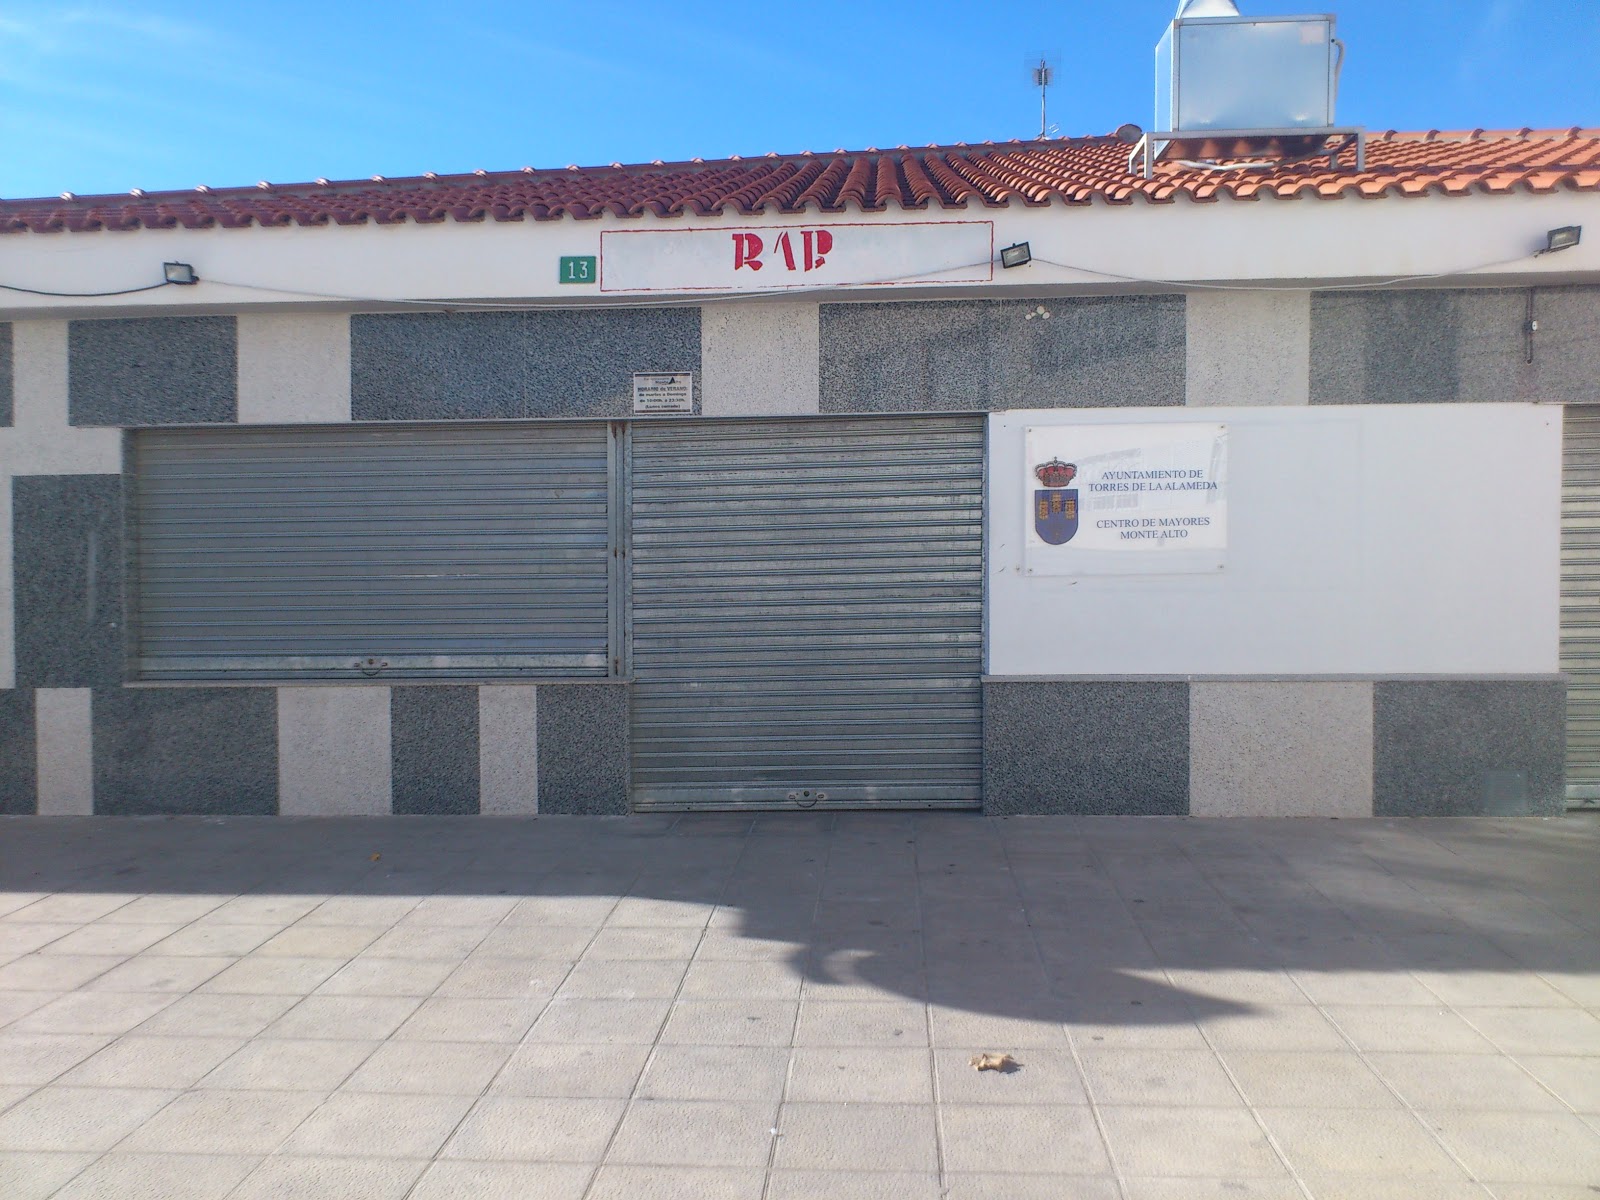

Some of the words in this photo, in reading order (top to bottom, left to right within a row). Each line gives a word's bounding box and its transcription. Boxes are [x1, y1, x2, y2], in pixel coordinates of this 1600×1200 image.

[568, 261, 588, 279] 13
[1101, 470, 1187, 480] AYUNTAMIENTO
[1189, 469, 1204, 479] DE
[1088, 482, 1130, 492] TORRES
[1132, 482, 1146, 491] DE
[1148, 481, 1163, 491] LA
[1166, 481, 1218, 491] ALAMEDA
[1096, 518, 1140, 529] CENTRO
[1142, 518, 1156, 527] DE
[1158, 517, 1210, 527] MAYORES
[1120, 530, 1159, 540] MONTE
[1160, 529, 1188, 539] ALTO
